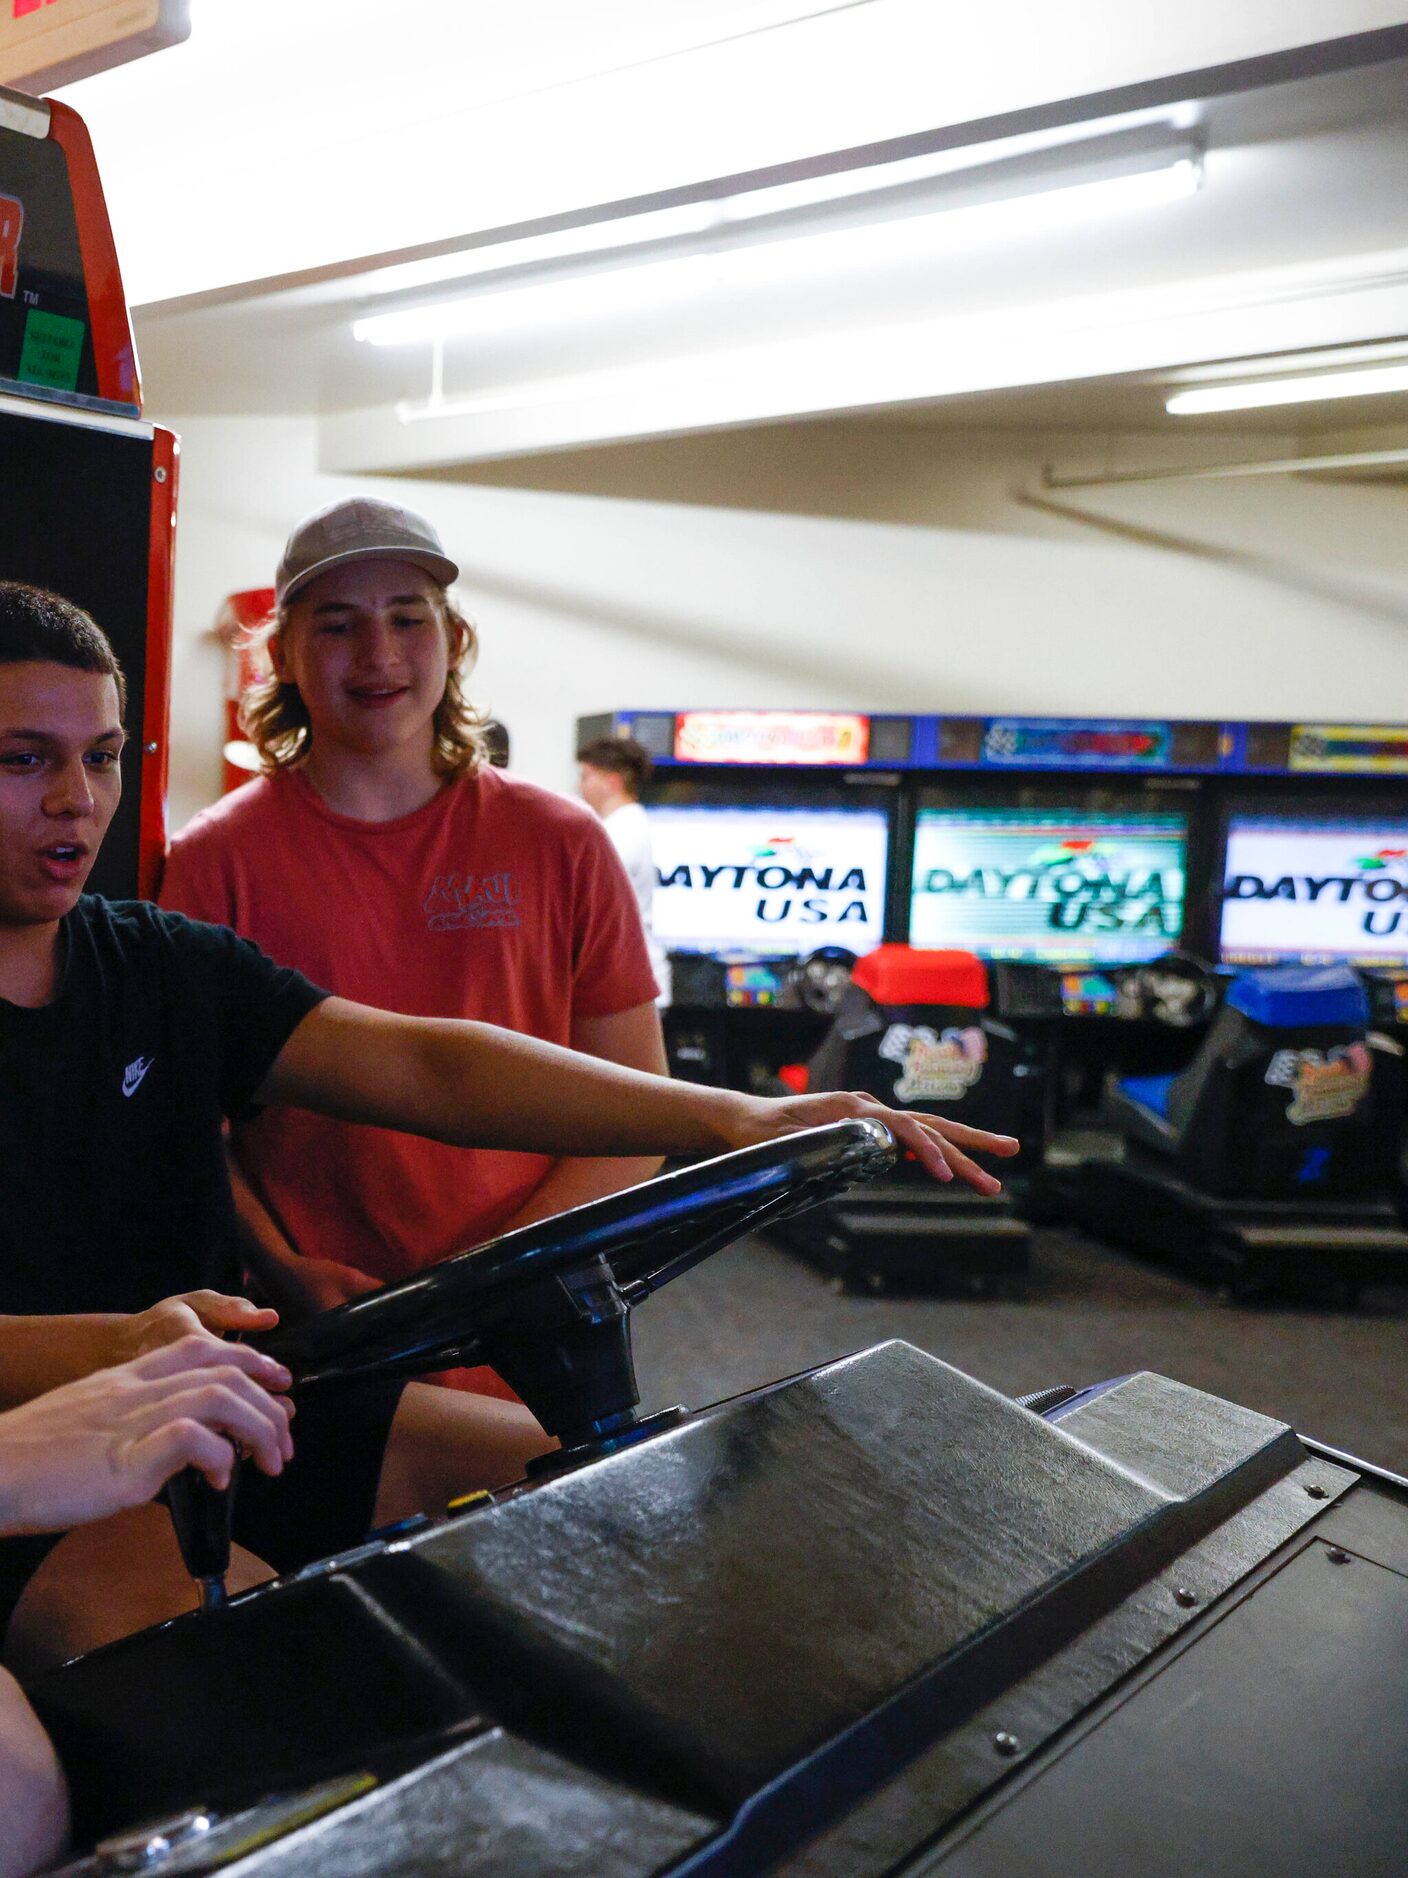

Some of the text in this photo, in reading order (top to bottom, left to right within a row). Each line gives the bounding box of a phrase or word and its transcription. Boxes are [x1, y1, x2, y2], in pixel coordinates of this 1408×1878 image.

[23, 290, 40, 305] TM
[655, 865, 866, 891] AYTONA
[925, 868, 1167, 899] DAYTONA
[1224, 875, 1408, 902] DAYTO
[756, 899, 867, 923] USA
[1048, 900, 1172, 931] USA
